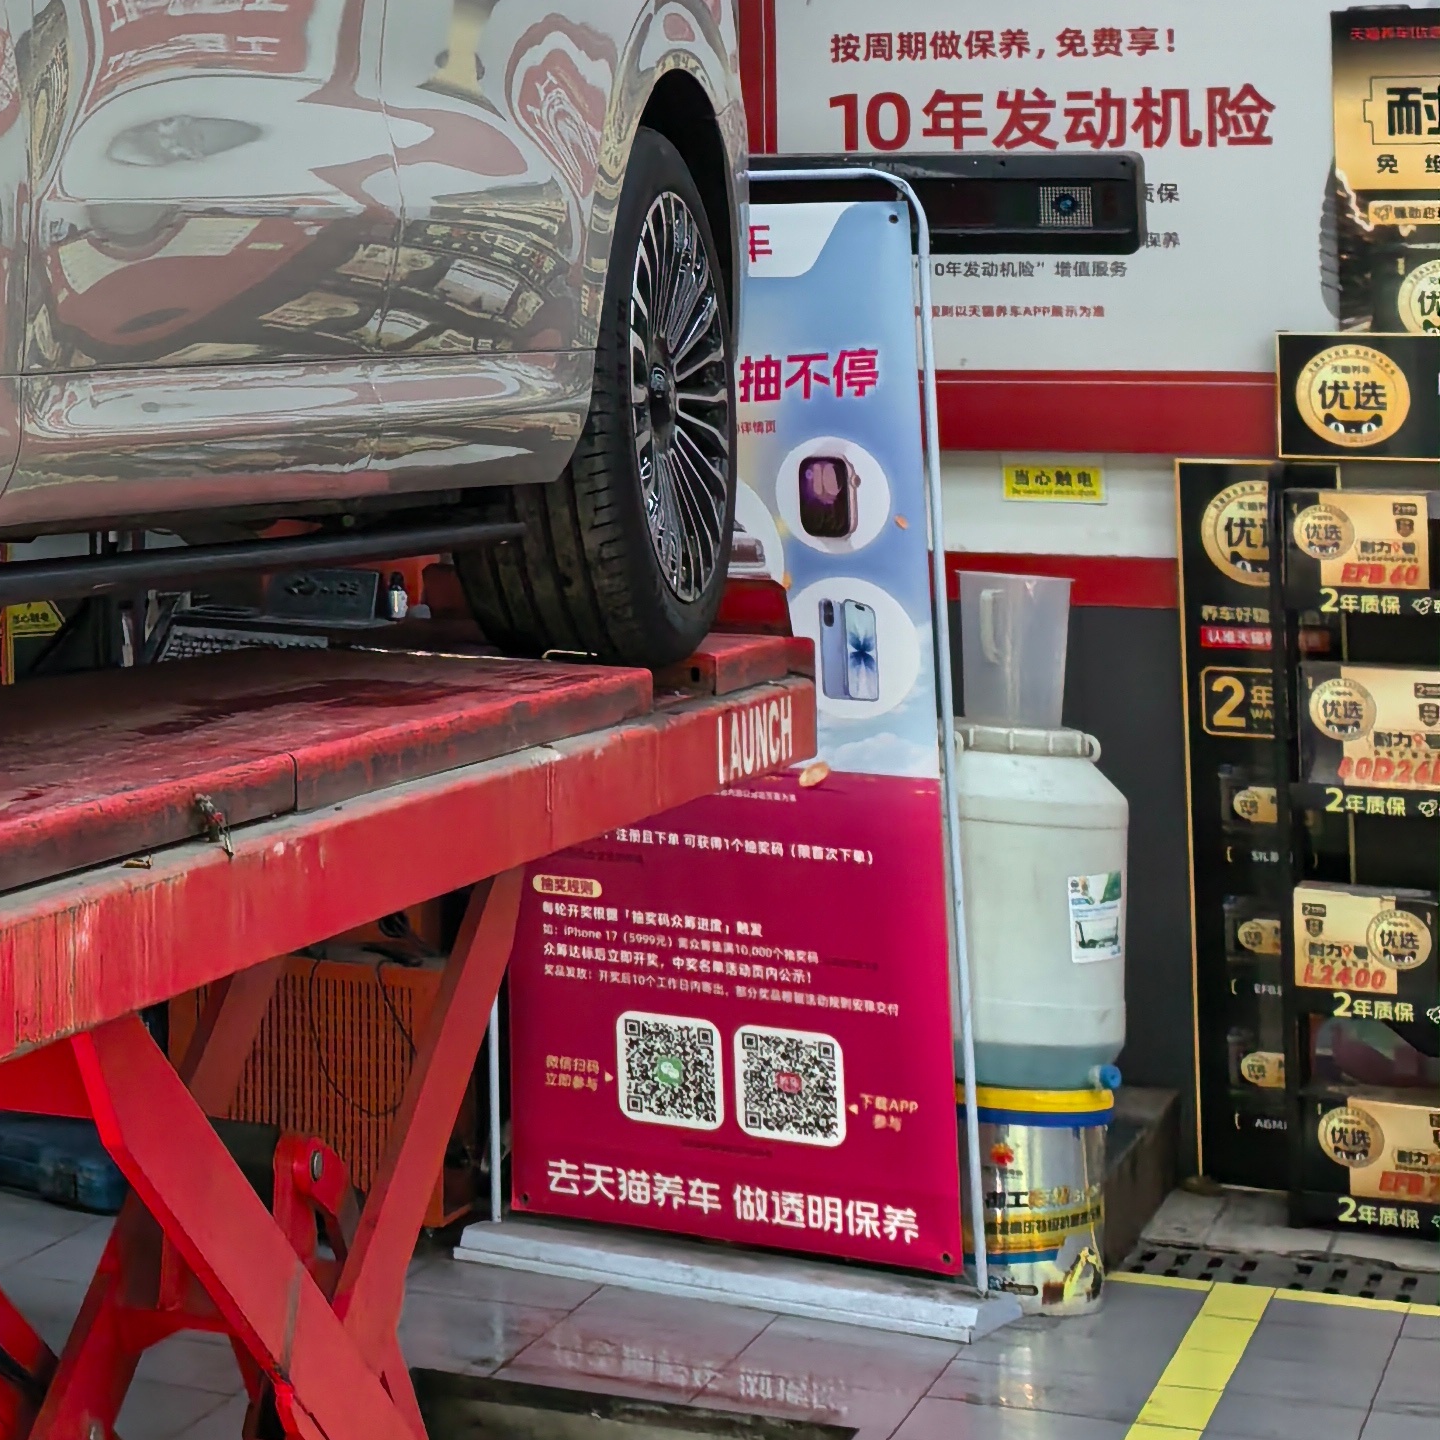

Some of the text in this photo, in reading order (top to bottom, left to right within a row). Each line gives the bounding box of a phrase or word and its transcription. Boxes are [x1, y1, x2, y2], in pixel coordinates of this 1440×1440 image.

[828, 83, 1277, 152] 10年发动机险
[1318, 380, 1388, 411] 优选
[1304, 522, 1343, 542] 优选
[1320, 588, 1401, 616] 2年质保
[1322, 699, 1364, 720] 优选
[718, 694, 793, 785] LAUNCH
[1325, 786, 1407, 817] 2年质保
[1380, 929, 1420, 951] 优选
[1333, 991, 1415, 1023] 2年质保
[546, 1158, 722, 1216] 去天猫养车
[731, 1182, 920, 1245] 做透明保养
[1337, 1195, 1420, 1230] 2年质保
